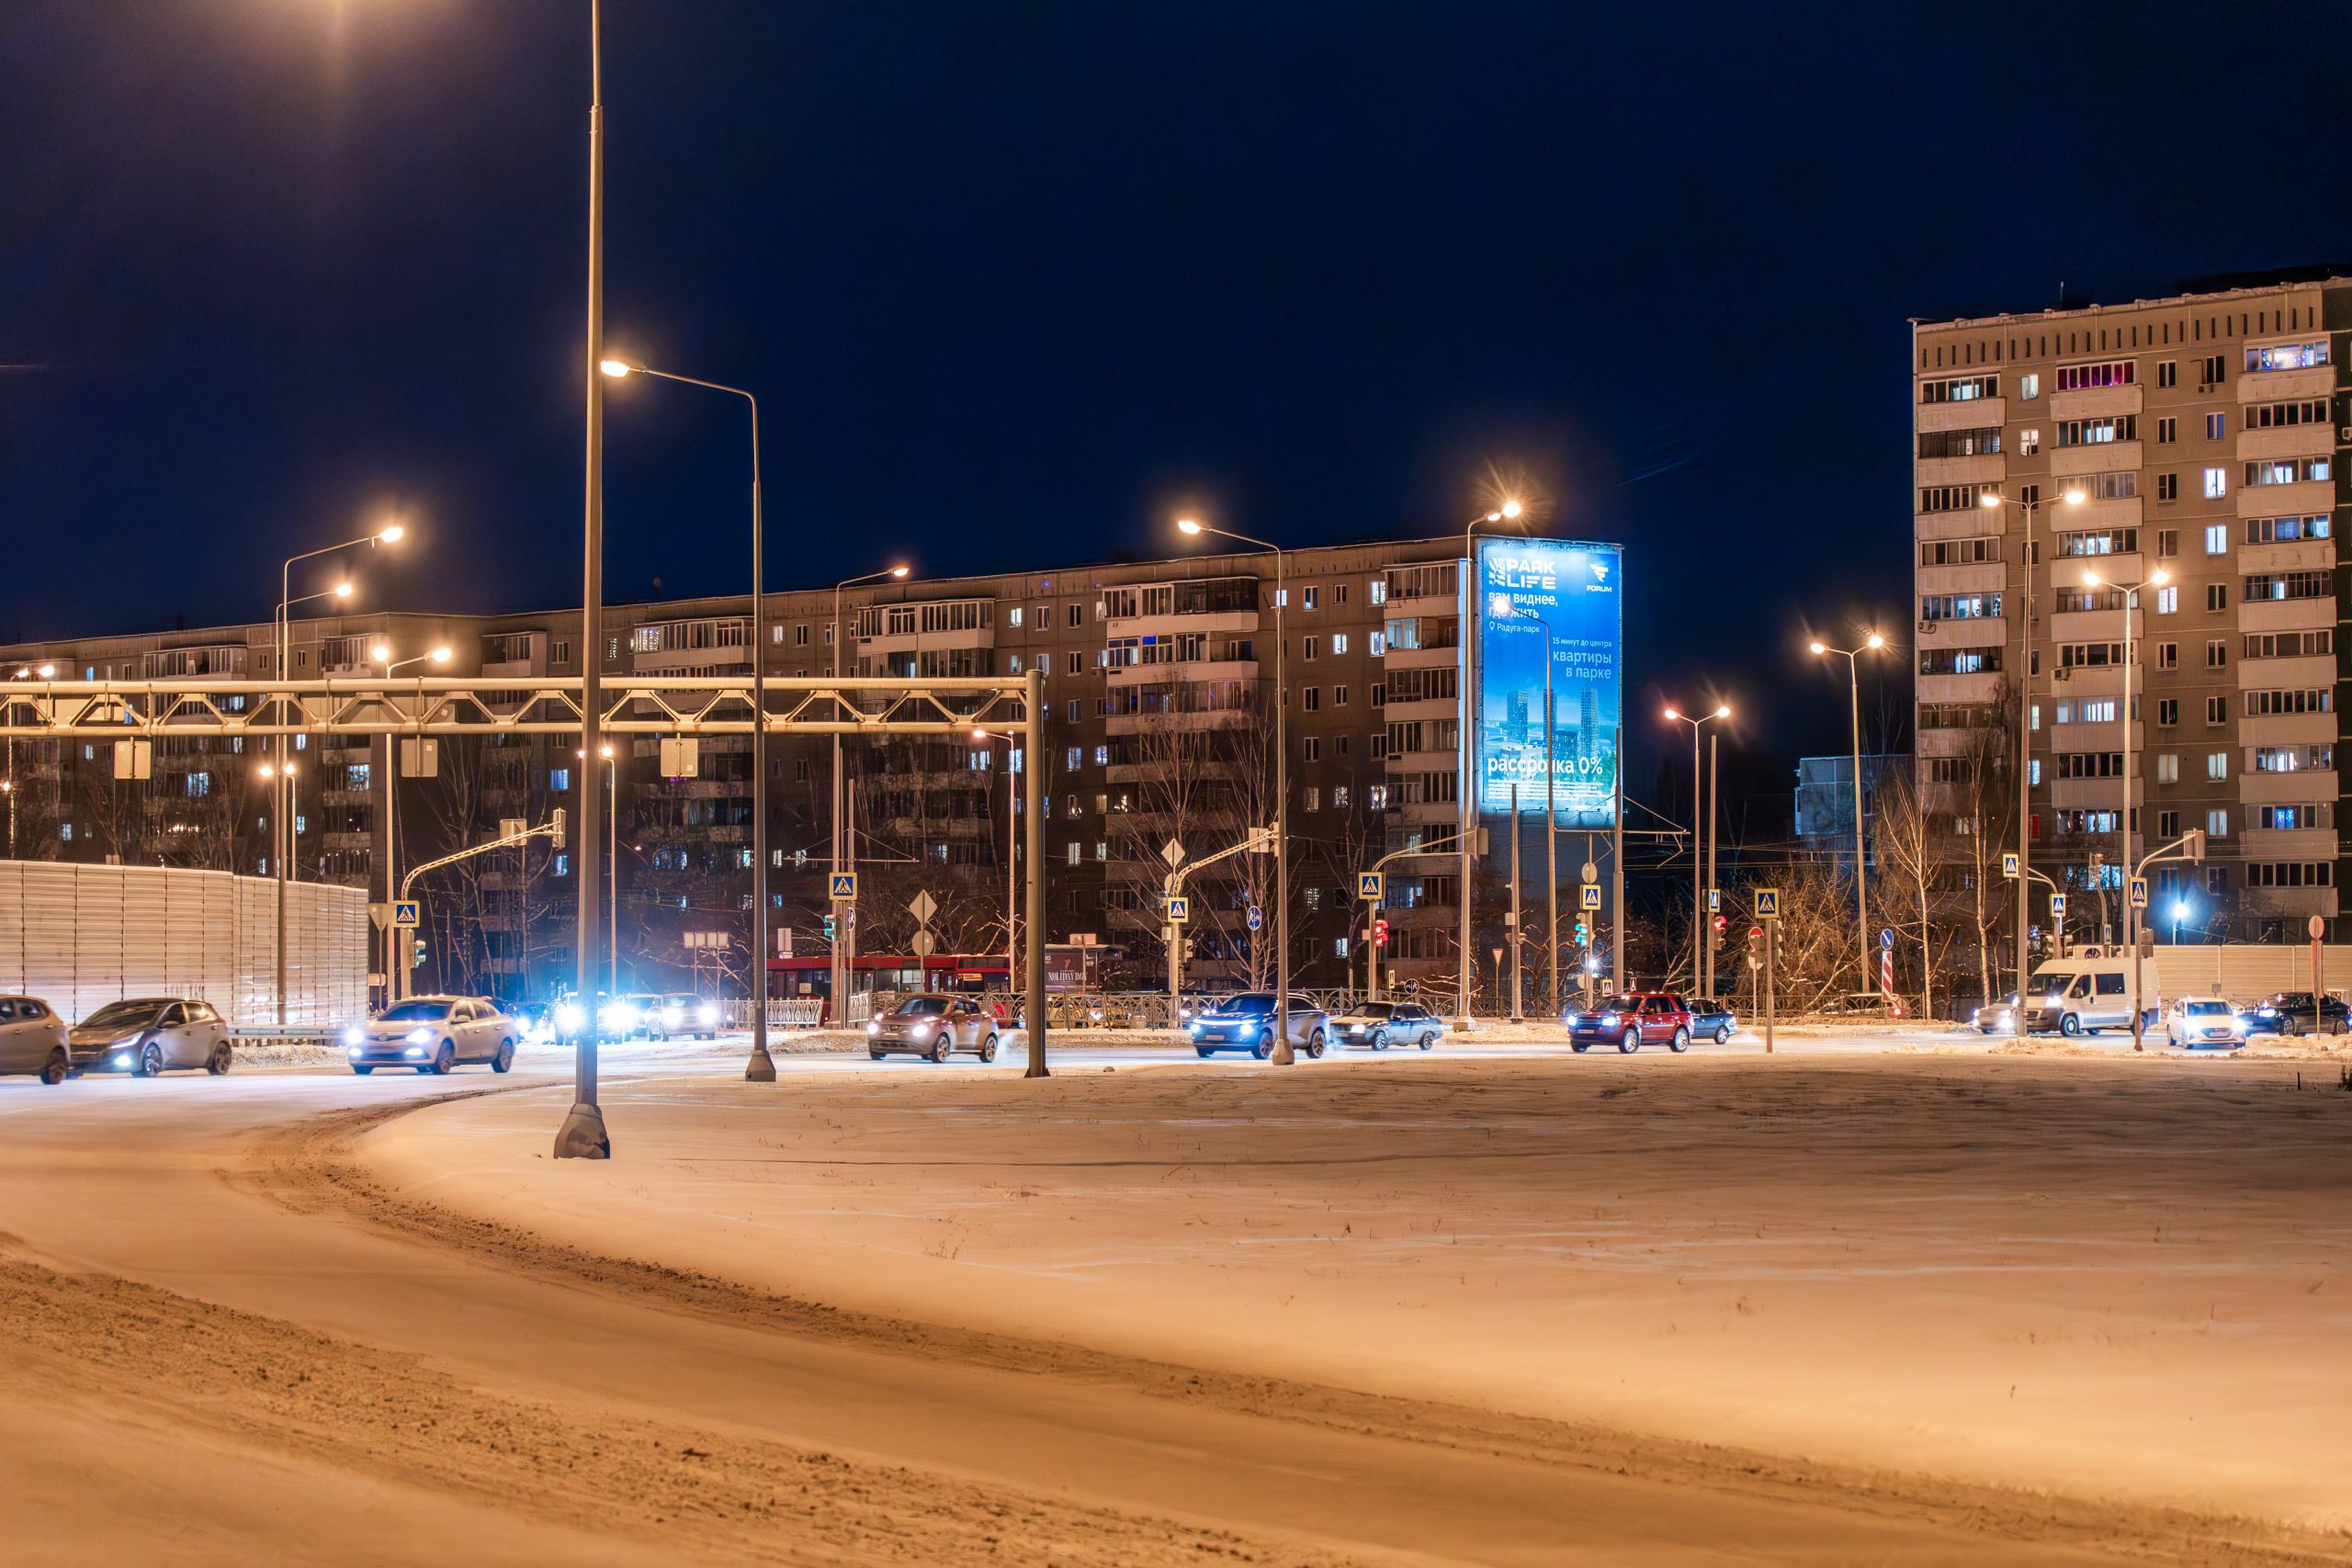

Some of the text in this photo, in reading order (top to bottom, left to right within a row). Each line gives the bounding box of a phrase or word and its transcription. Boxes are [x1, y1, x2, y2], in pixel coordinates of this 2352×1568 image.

[1507, 558, 1556, 575] PARK
[1507, 574, 1556, 590] LIFE
[1586, 584, 1612, 592] FORUM
[1513, 592, 1558, 607] виднее,
[1510, 607, 1540, 619] жить
[1497, 622, 1541, 635] Радуга-парк
[1560, 638, 1580, 648] минут
[1580, 639, 1589, 648] до
[1589, 640, 1612, 649] центра
[1553, 650, 1612, 667] квартиры
[1566, 667, 1612, 682] в парке
[1578, 756, 1603, 774] 0%
